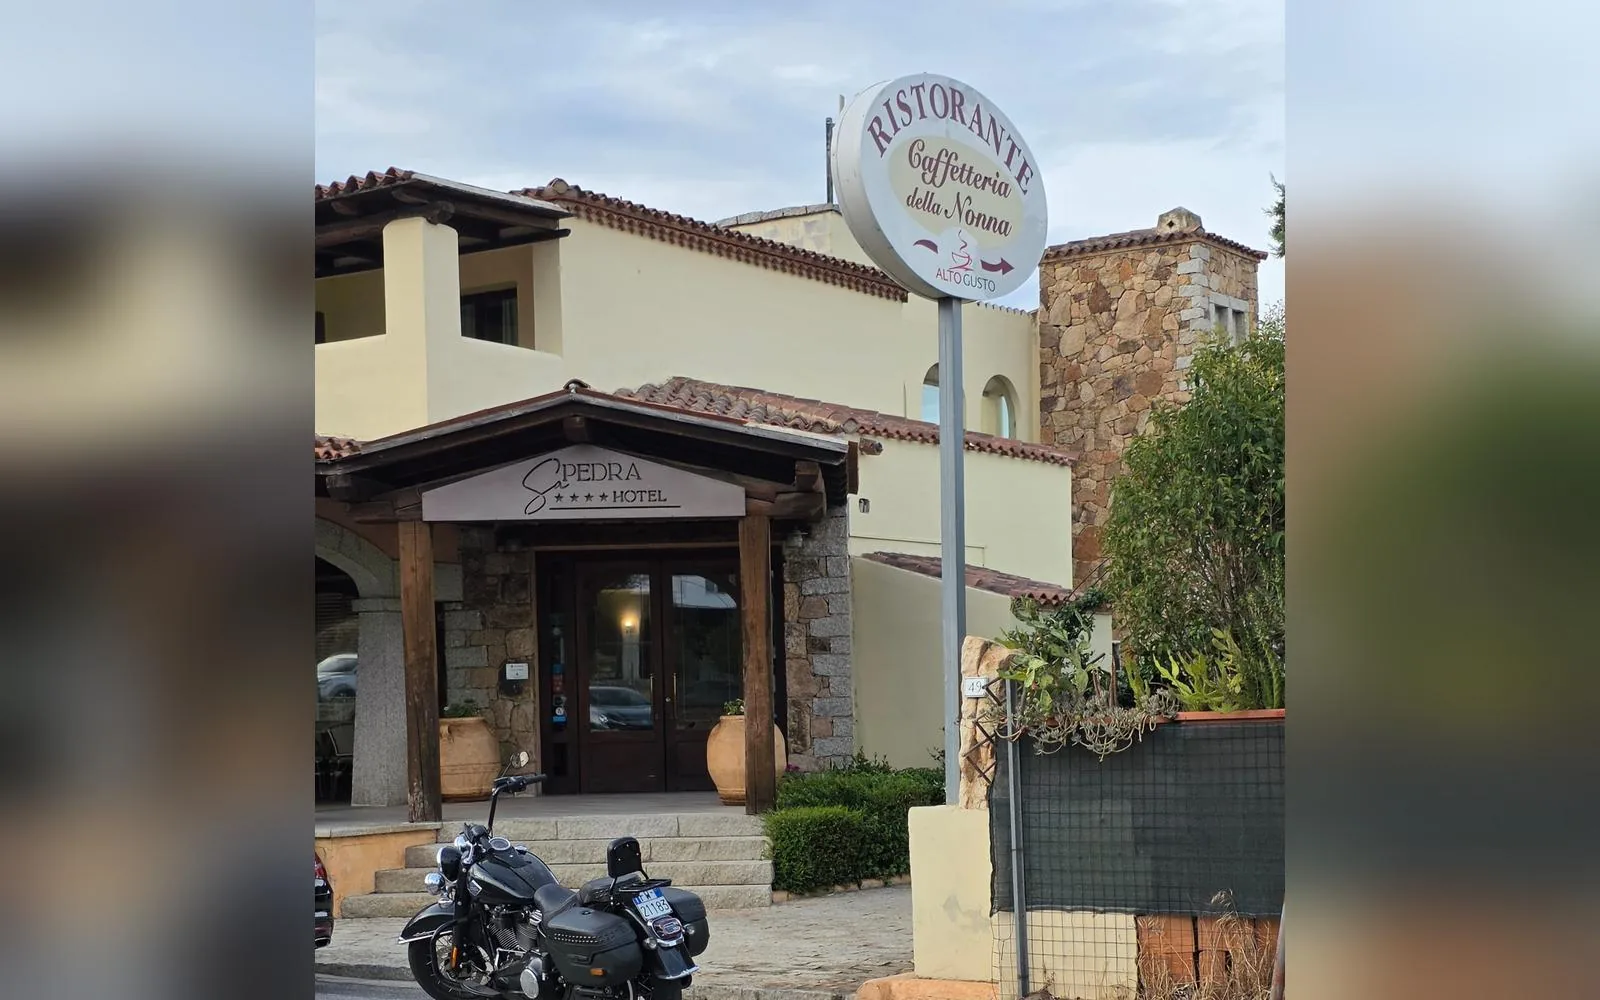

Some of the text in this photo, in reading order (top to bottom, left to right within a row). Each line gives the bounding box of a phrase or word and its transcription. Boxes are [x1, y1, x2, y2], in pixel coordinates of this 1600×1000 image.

[867, 82, 1034, 195] RISTORANTE
[908, 139, 1012, 198] Caffetteria
[906, 187, 1012, 237] della Nonna
[522, 458, 642, 515] Sa PEDRA
[612, 490, 667, 503] HOTEL
[969, 681, 982, 692] 49
[640, 899, 669, 917] 21183
